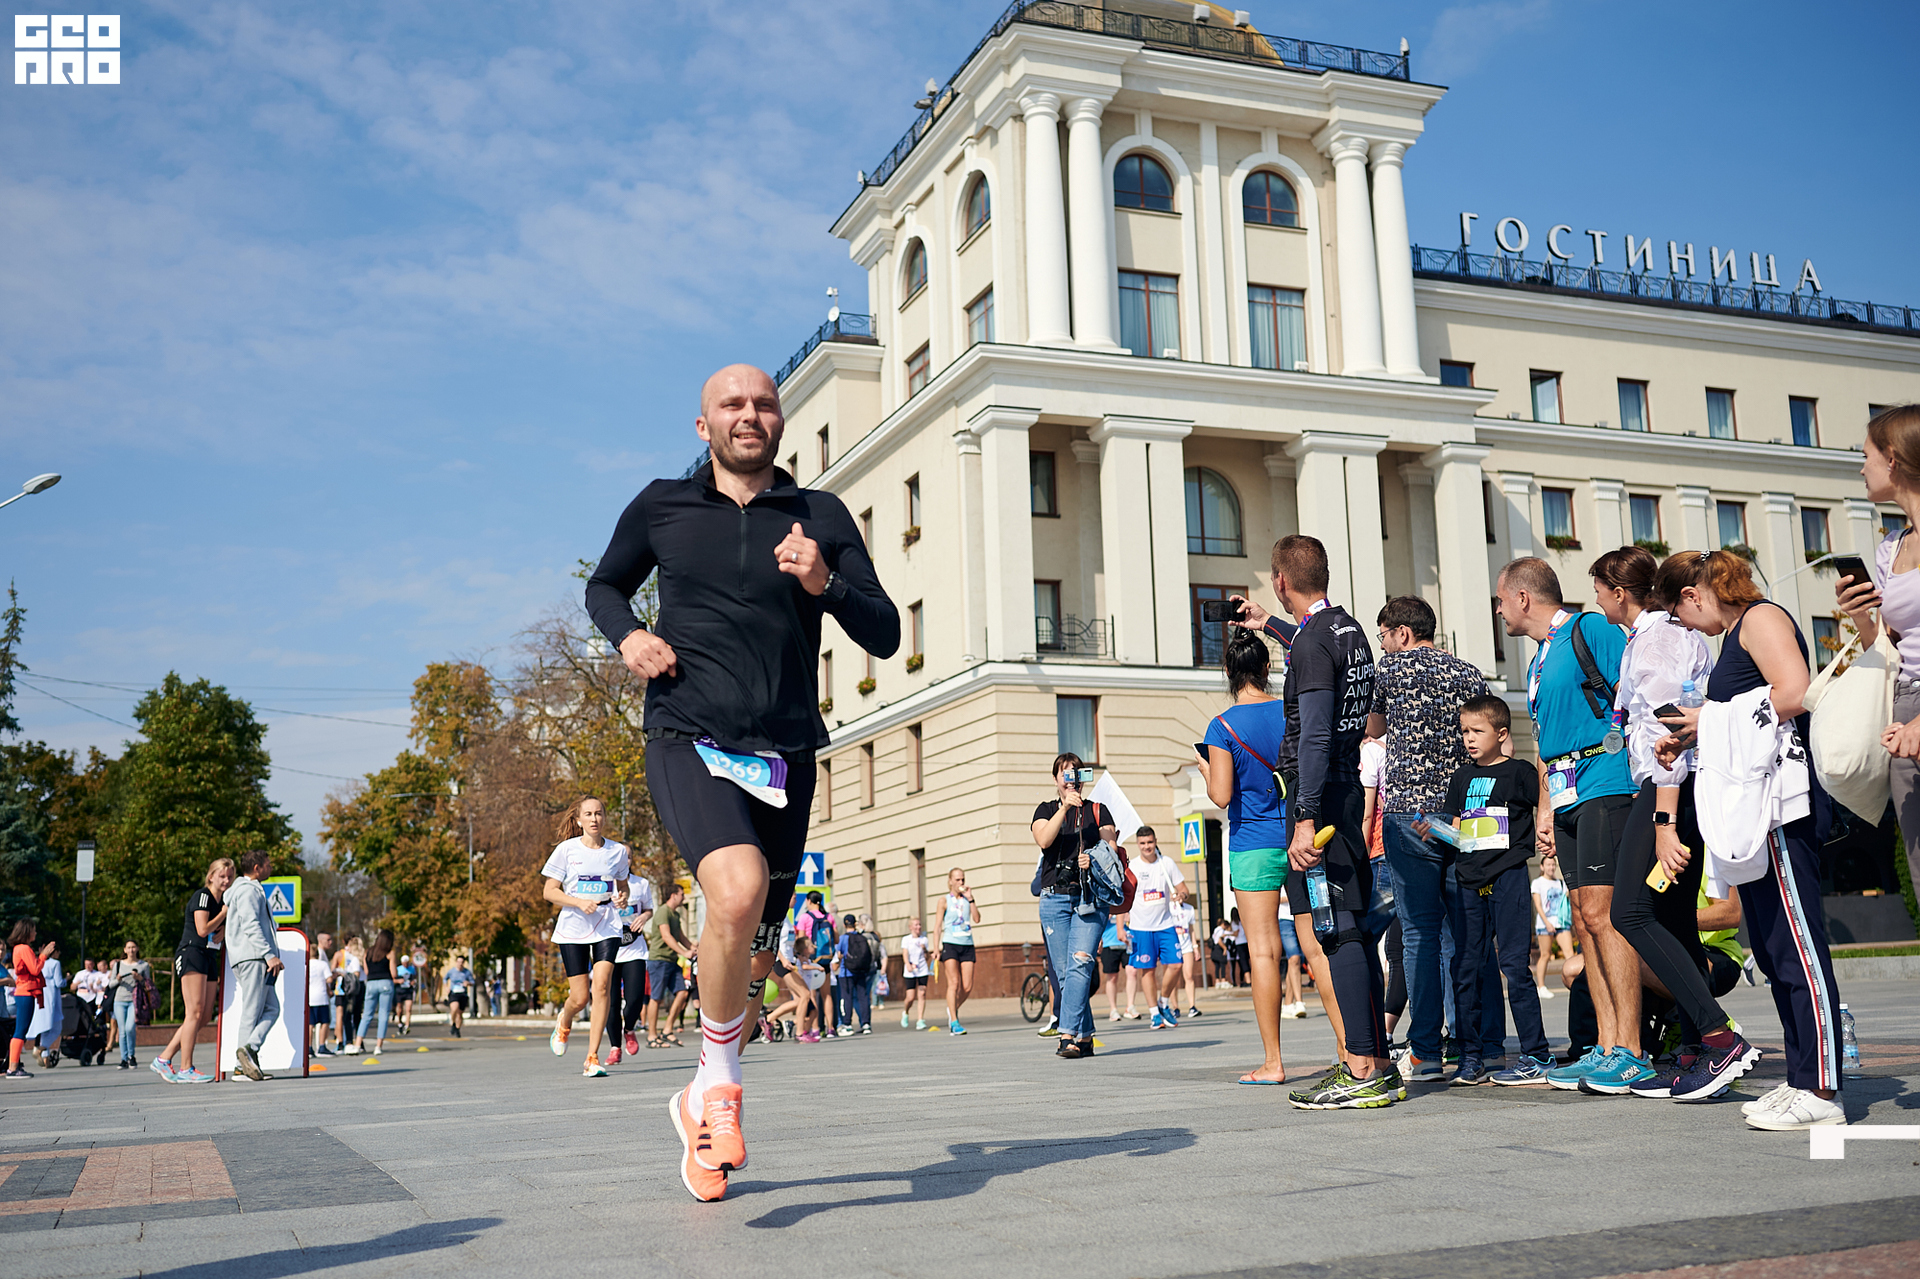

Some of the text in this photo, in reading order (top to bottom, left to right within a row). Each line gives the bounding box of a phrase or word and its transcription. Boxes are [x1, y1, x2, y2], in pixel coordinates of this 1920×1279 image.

[1459, 212, 1822, 292] ГОСТИНИЦА
[1354, 647, 1367, 664] AM
[1346, 663, 1375, 682] SUPER
[1344, 682, 1370, 699] AND
[1342, 702, 1347, 716] I
[1471, 819, 1478, 838] 1
[582, 883, 603, 892] 1451
